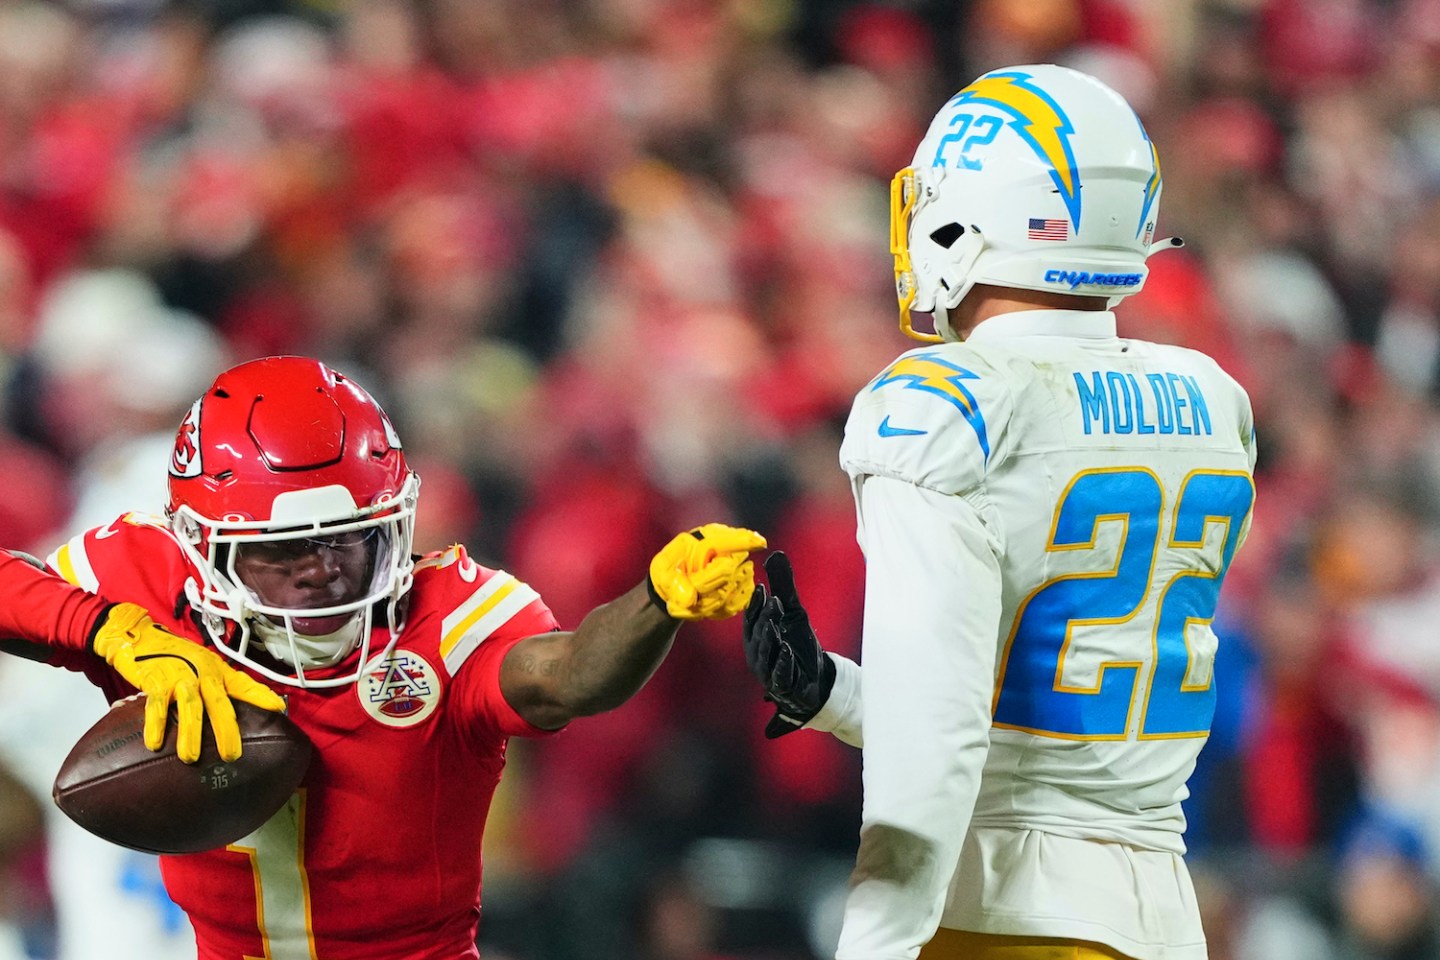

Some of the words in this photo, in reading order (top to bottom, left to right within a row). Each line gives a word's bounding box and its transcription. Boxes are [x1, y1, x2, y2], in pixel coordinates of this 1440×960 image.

[933, 113, 1004, 171] 22
[1044, 269, 1143, 290] CHARGERS
[1073, 371, 1212, 436] MOLDEN
[992, 466, 1256, 741] 22
[211, 773, 229, 790] 315
